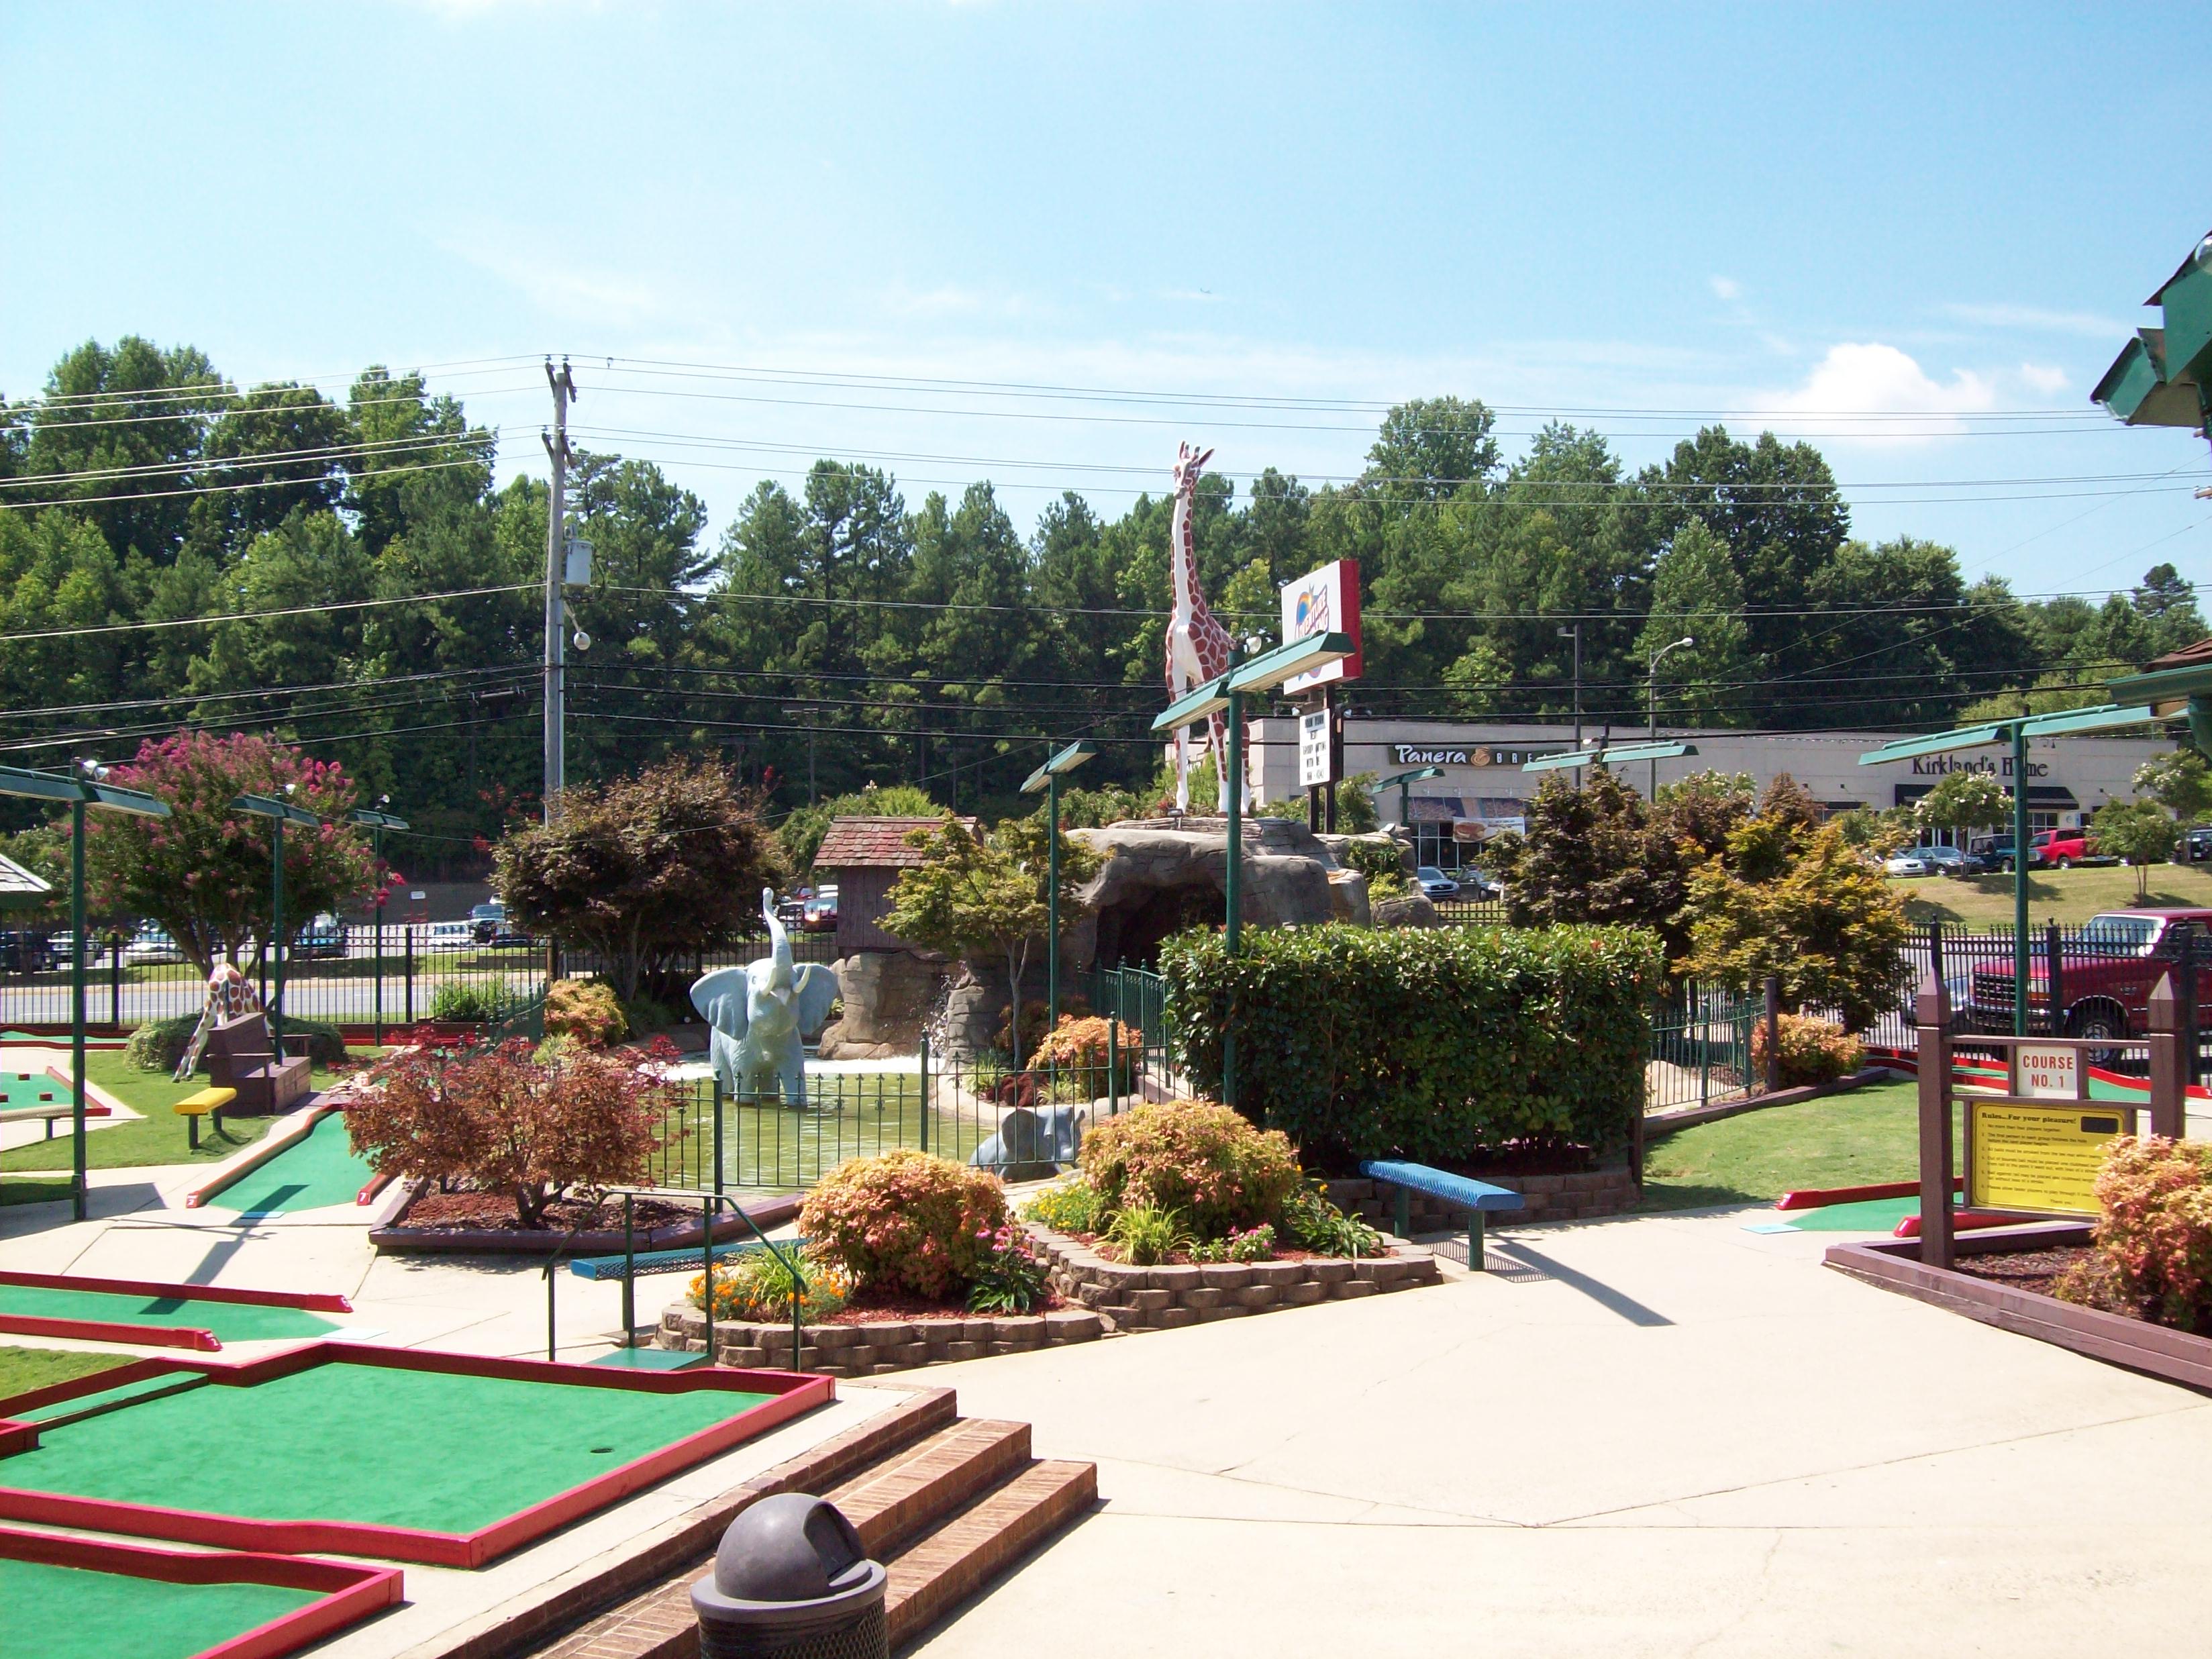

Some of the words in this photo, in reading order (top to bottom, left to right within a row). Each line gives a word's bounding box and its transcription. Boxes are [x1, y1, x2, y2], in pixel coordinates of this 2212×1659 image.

[1395, 744, 1466, 764] Panera
[1495, 752, 1546, 764] BRE
[1912, 754, 1996, 775] Kirkland's
[2002, 757, 2049, 777] Hme
[2022, 1055, 2074, 1070] COURSE
[2031, 1074, 2054, 1088] NO.
[2059, 1075, 2064, 1088] 1
[359, 1192, 367, 1202] 7
